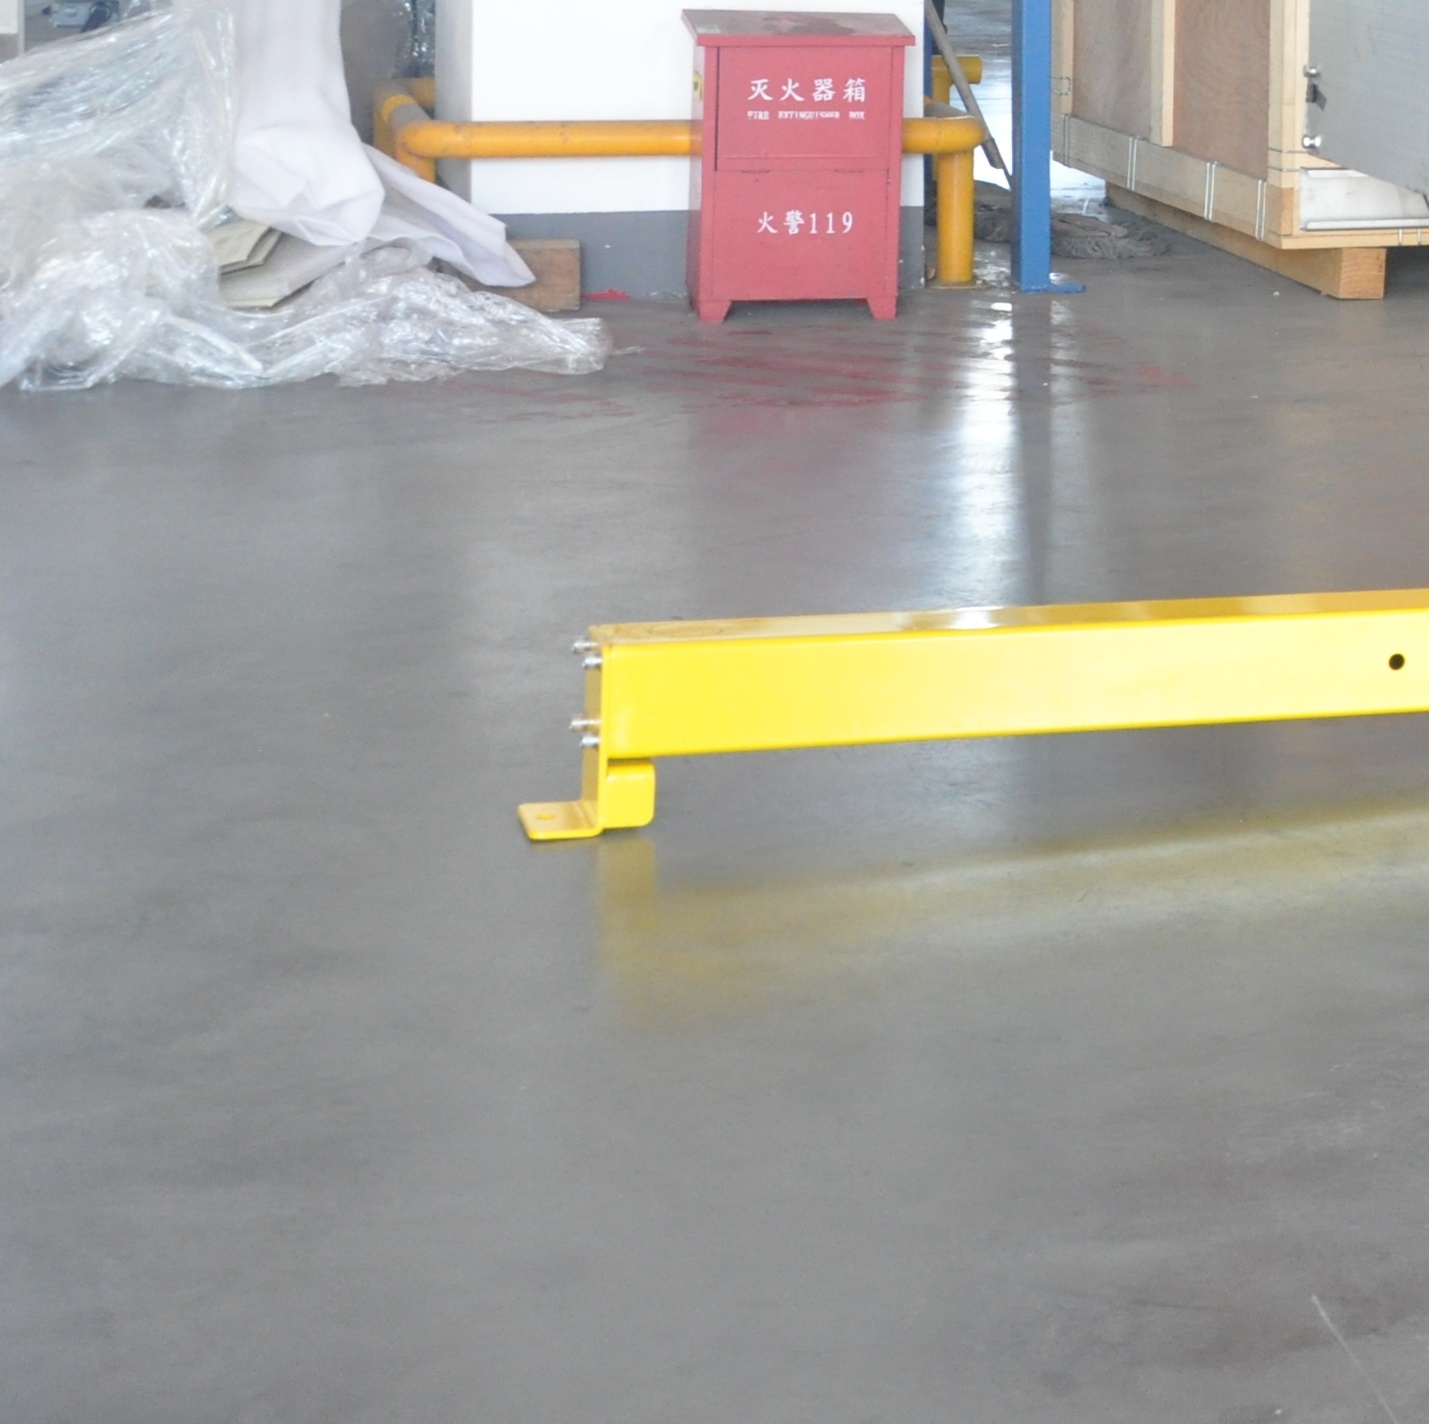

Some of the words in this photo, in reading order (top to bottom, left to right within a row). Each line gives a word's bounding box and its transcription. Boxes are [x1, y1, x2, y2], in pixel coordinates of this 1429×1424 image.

[747, 78, 866, 102] 灭火器箱
[747, 110, 770, 120] FIRE
[757, 210, 853, 235] 火警119
